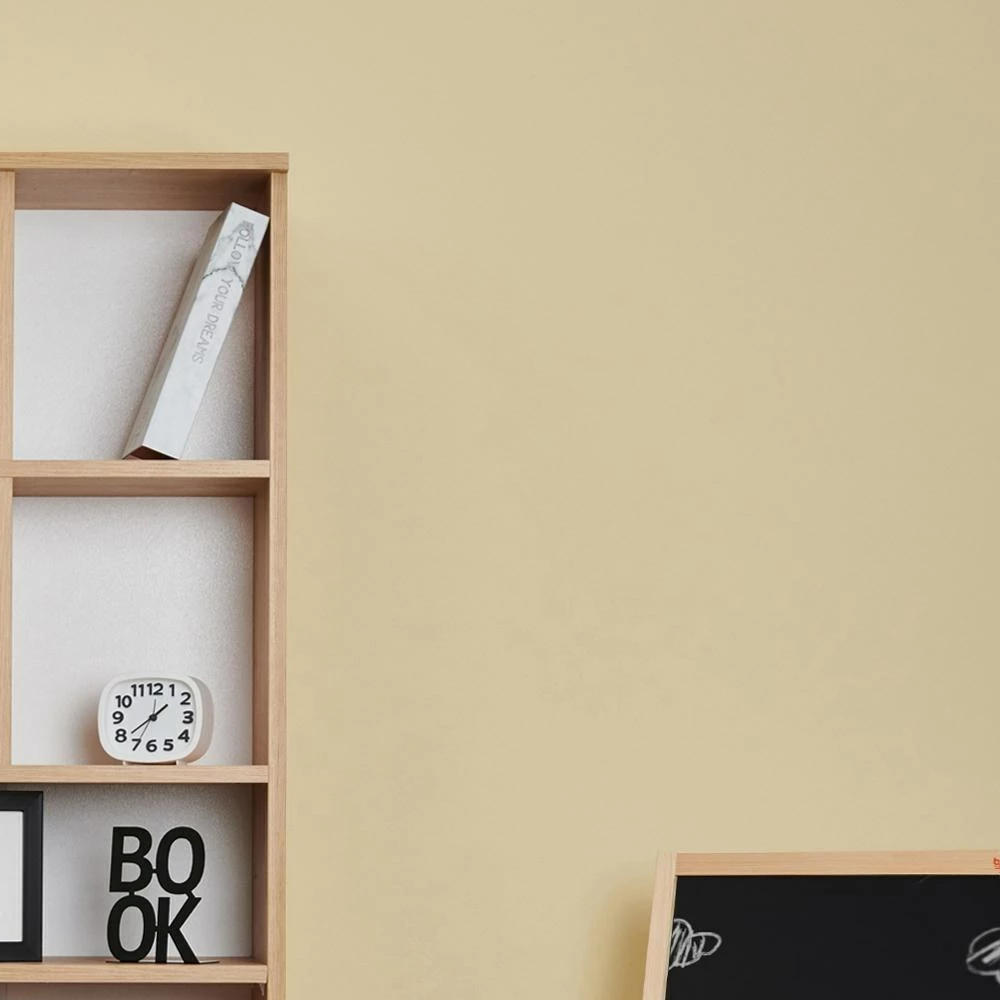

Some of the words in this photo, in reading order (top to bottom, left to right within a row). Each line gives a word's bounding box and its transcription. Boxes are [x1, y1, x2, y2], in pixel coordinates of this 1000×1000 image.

[210, 278, 234, 314] YOUR
[191, 313, 220, 366] DREAMS
[131, 684, 145, 697] 11
[147, 683, 164, 696] 12
[169, 684, 175, 697] 1
[115, 695, 132, 709] 10
[180, 692, 192, 705] 2
[112, 711, 124, 725] 9
[182, 711, 194, 724] 3
[115, 728, 127, 743] 8
[177, 729, 190, 743] 4
[131, 738, 142, 751] 7
[146, 739, 158, 753] 6
[163, 739, 174, 751] 5
[109, 826, 205, 895] BO
[107, 894, 202, 964] OK
